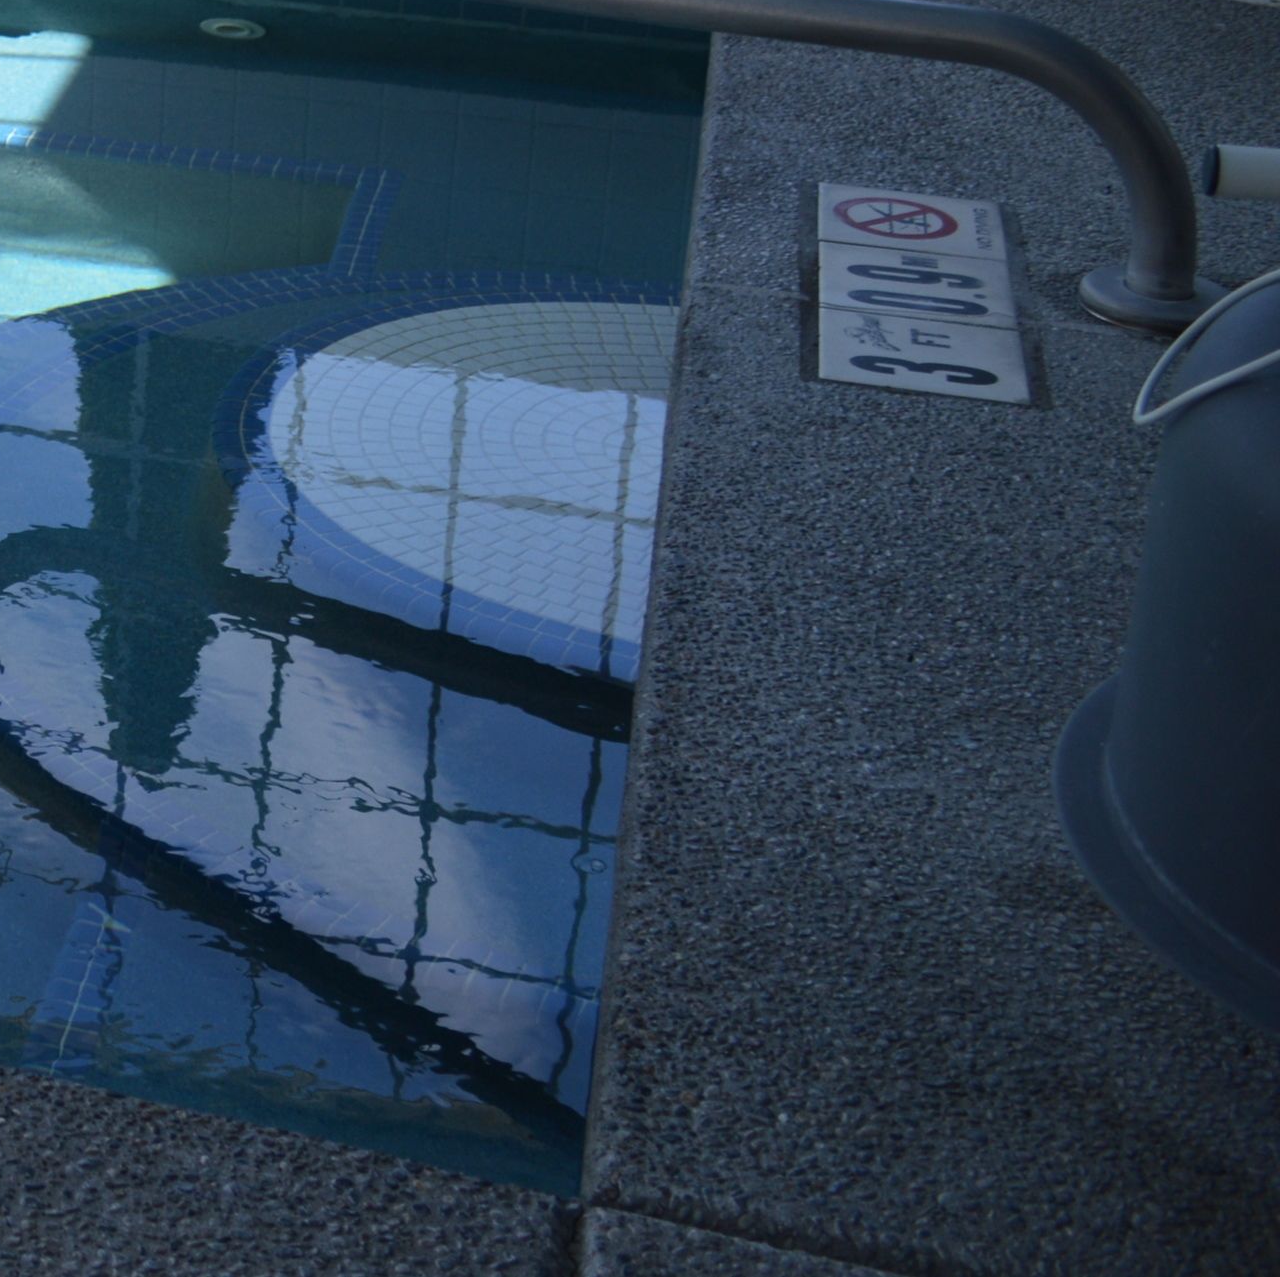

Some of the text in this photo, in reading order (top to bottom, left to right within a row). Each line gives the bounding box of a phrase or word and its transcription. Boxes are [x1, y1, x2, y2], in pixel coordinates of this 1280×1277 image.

[975, 236, 993, 252] NO
[900, 255, 939, 270] M
[847, 264, 989, 316] 0.9
[910, 327, 951, 349] FT
[849, 355, 999, 386] 3
